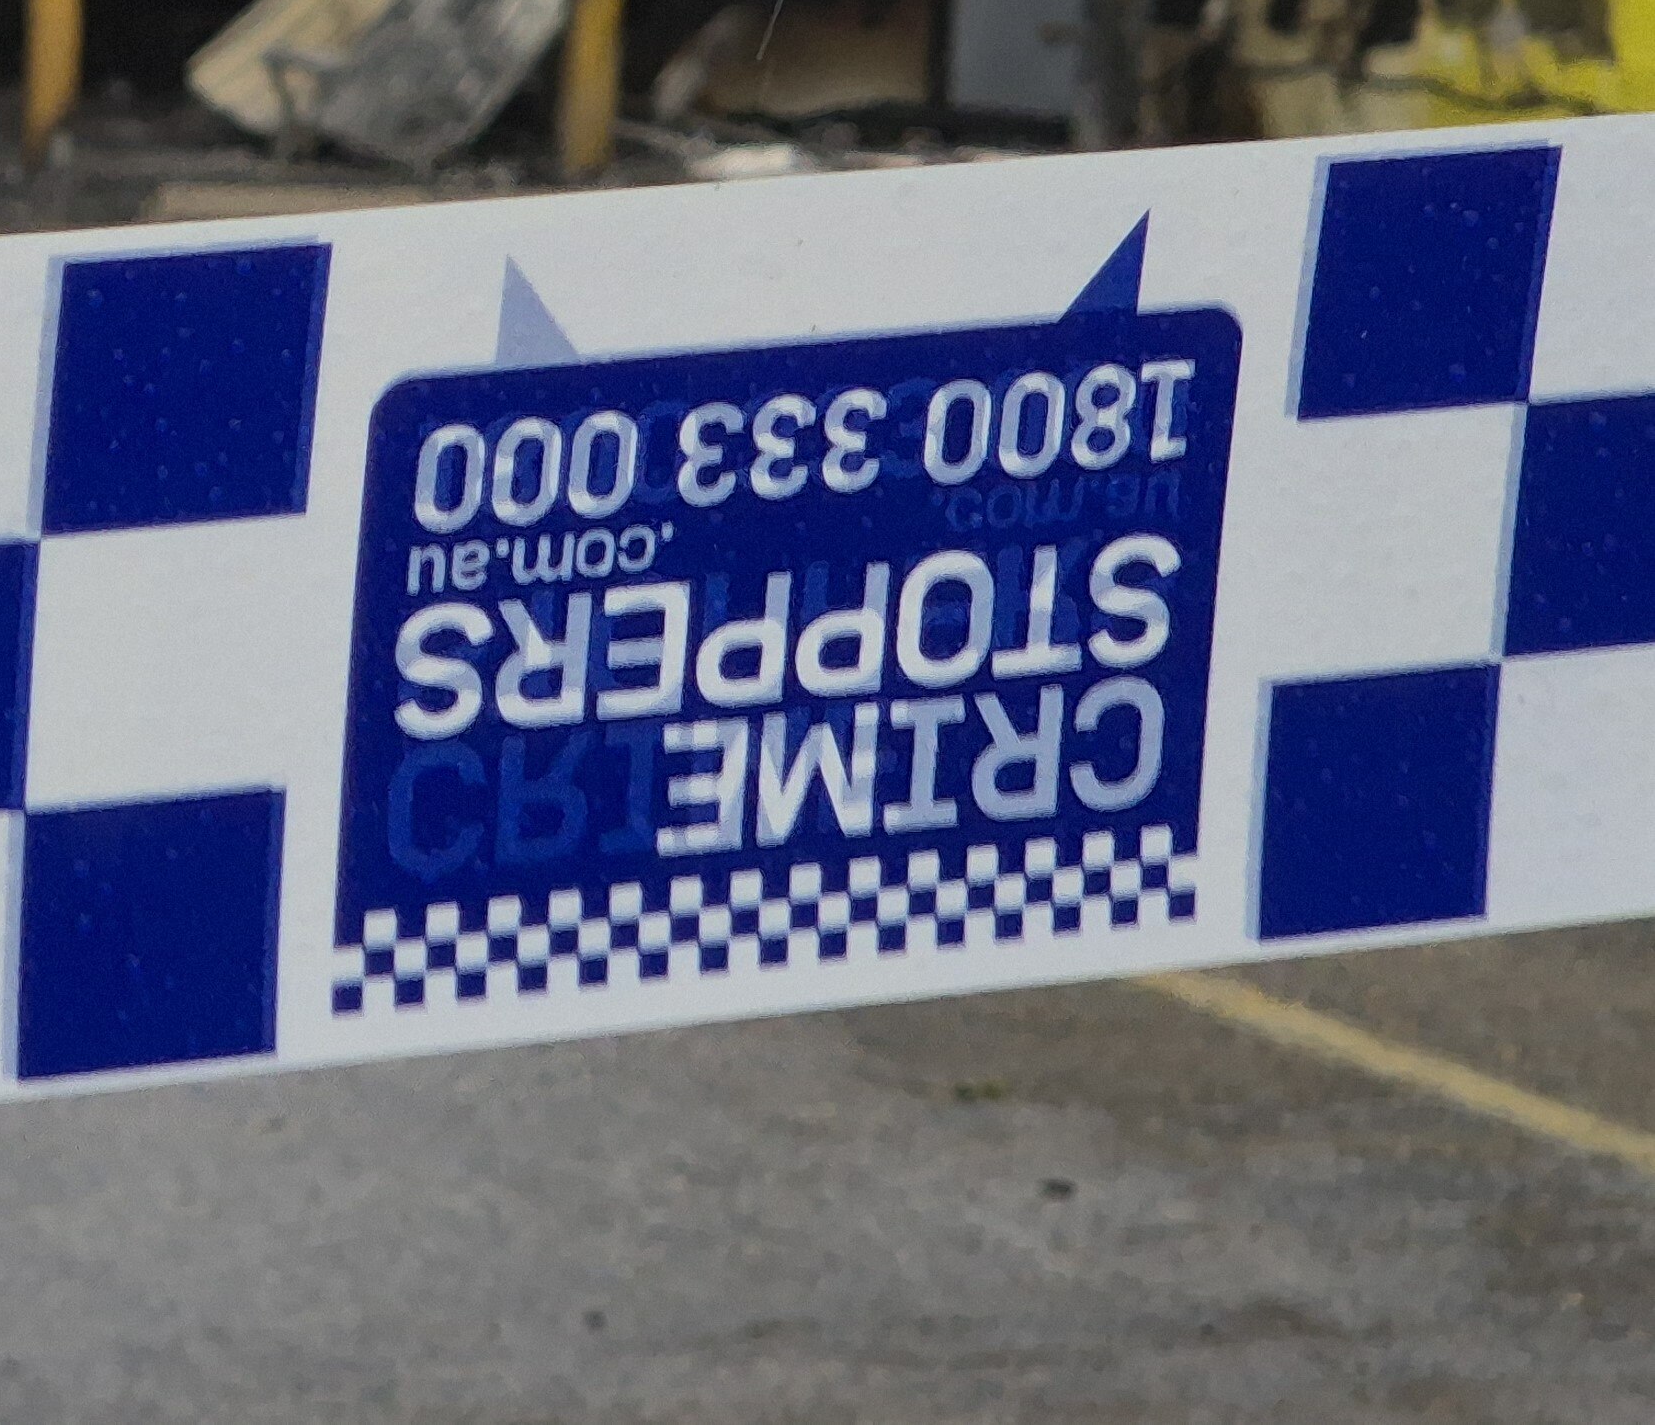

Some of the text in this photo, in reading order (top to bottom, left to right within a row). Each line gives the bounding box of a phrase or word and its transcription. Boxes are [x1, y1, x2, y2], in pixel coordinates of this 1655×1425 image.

[412, 357, 1198, 535] 1800 333 000
[393, 534, 1182, 740] STOPPERS
[406, 521, 674, 595] .com.au
[656, 675, 1168, 858] CRIME
